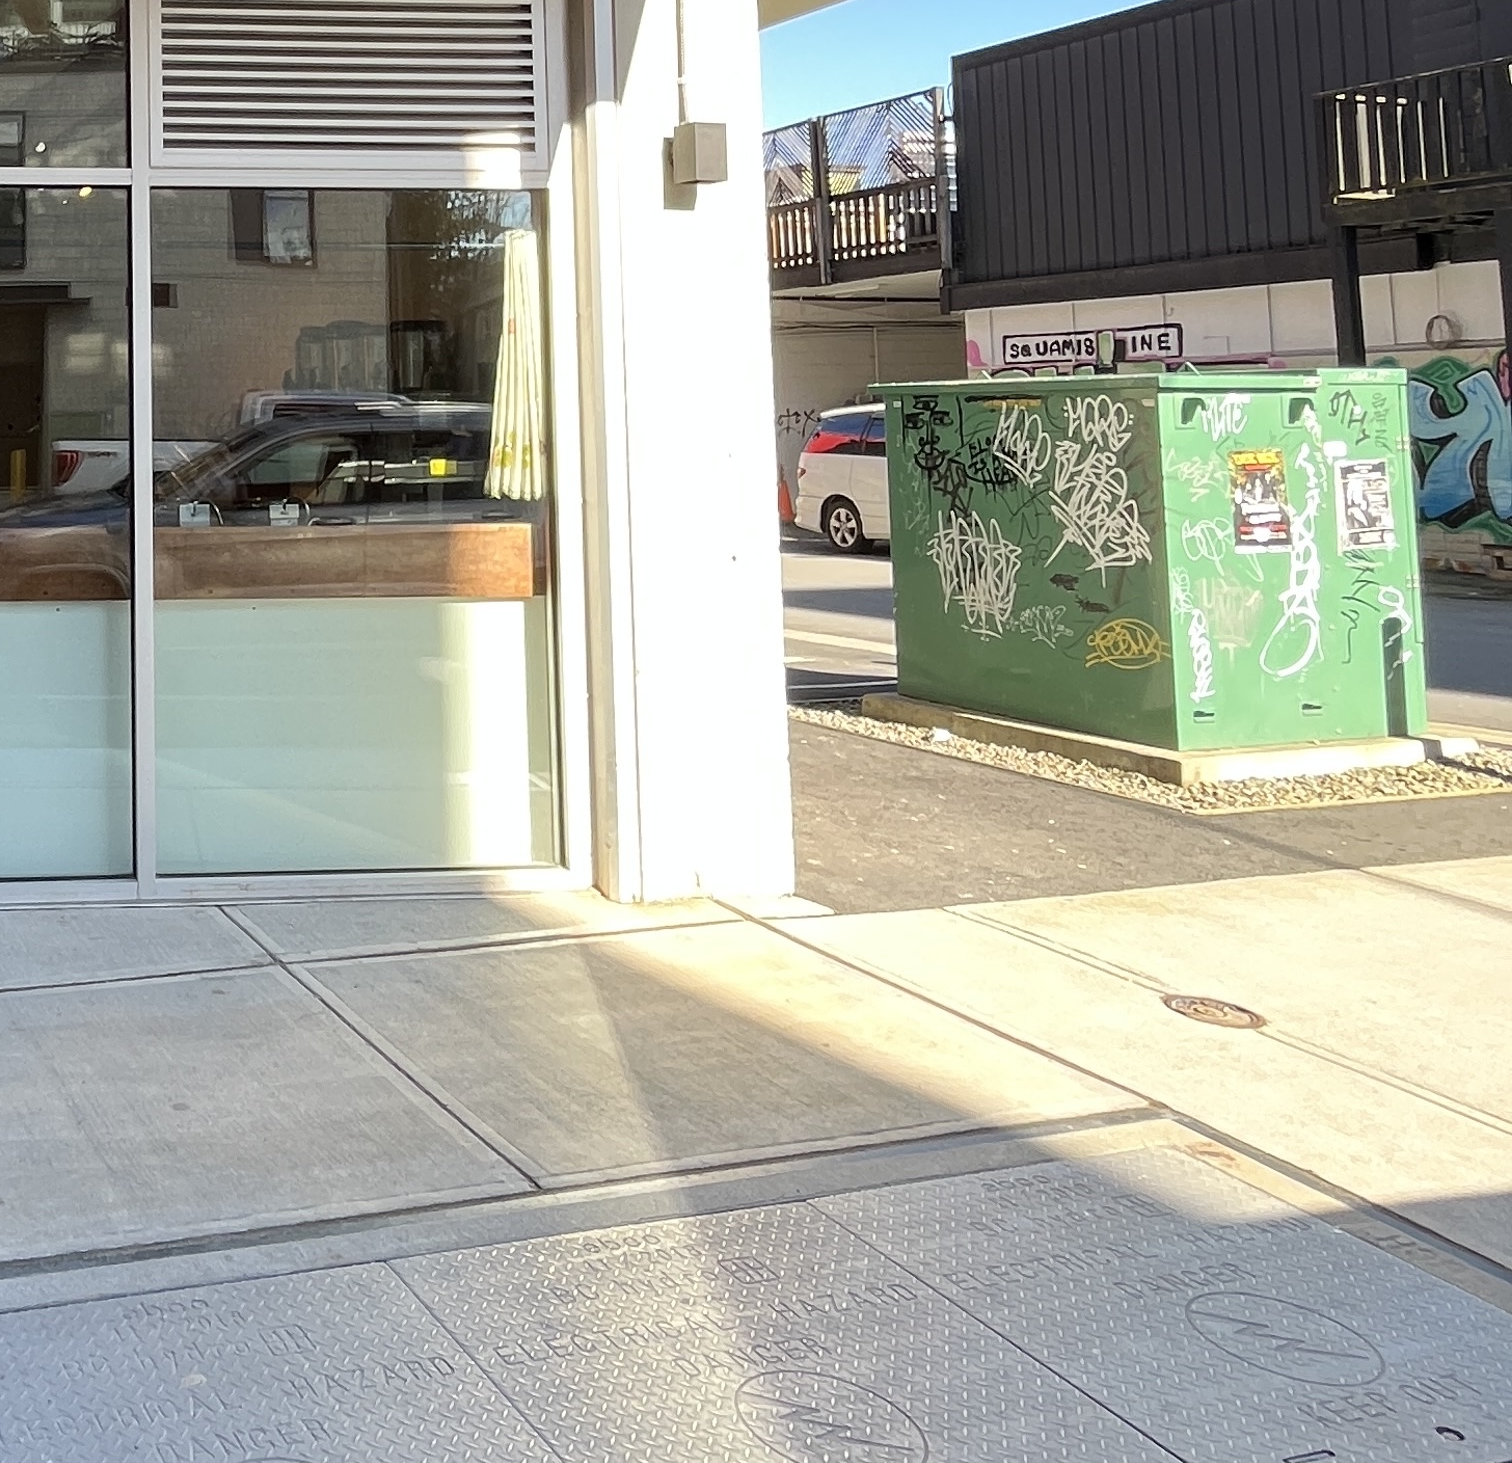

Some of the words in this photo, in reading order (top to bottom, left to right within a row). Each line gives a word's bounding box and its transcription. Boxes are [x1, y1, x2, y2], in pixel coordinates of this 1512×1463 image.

[943, 1243, 1159, 1291] ELECTRICAL
[1175, 1217, 1312, 1248] HAZARD
[550, 1283, 600, 1304] BC
[610, 1269, 720, 1298] hydro
[1112, 1262, 1257, 1300] DANGER
[492, 1310, 737, 1366] ELECTRICAL
[767, 1283, 919, 1322] HAZARD
[288, 1356, 456, 1400] HAZARD
[671, 1337, 833, 1378] DANGER
[1296, 1391, 1398, 1428] KEEP
[1398, 1373, 1482, 1406] OUT
[155, 1417, 332, 1463] DANGER
